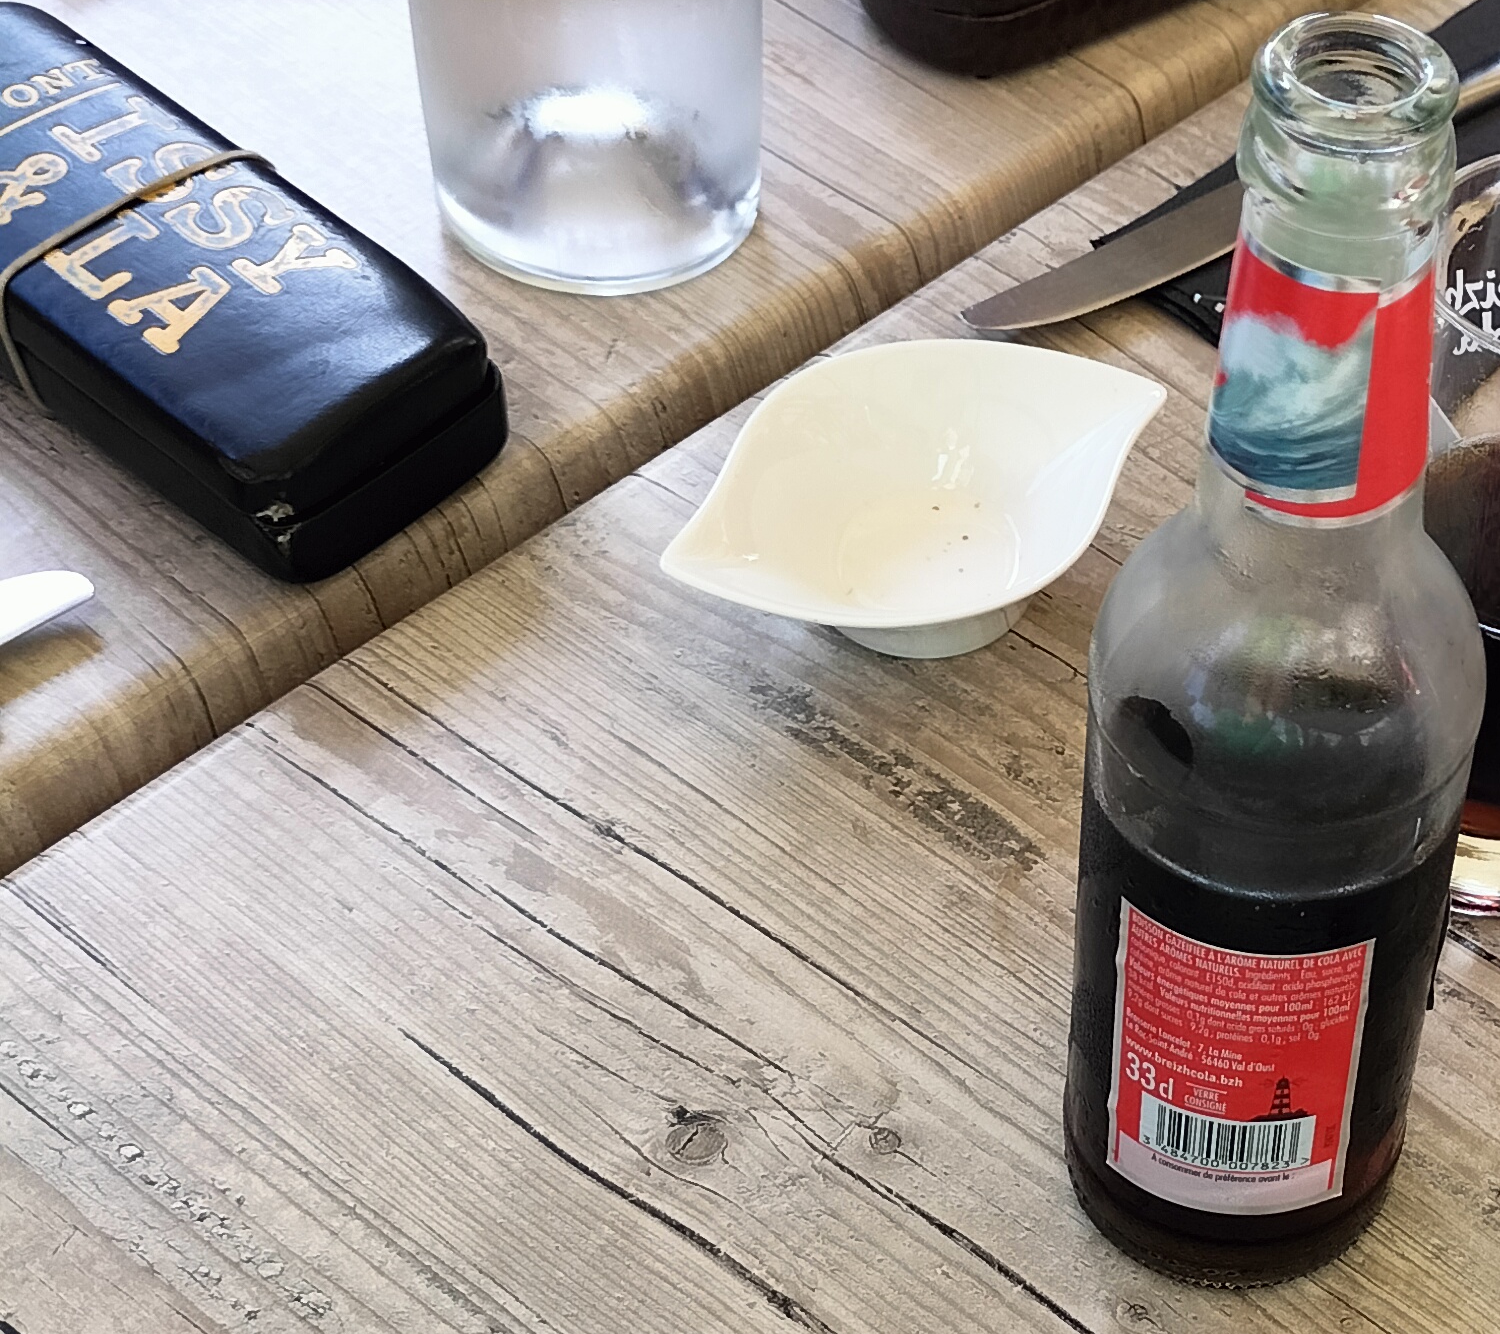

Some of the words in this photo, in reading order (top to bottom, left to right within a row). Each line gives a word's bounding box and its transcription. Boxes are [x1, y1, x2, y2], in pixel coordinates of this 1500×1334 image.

[1131, 923, 1158, 948] AUTRES
[1260, 959, 1300, 970] NATUREL
[1303, 958, 1315, 968] DE
[1317, 953, 1340, 966] COLA
[1342, 946, 1363, 962] AVEC
[1211, 997, 1256, 1013] moyennes
[1258, 1003, 1280, 1014] pour
[1252, 1014, 1298, 1025] moyennes
[1299, 1011, 1320, 1023] pour
[1158, 1027, 1190, 1049] Lancelot
[1208, 1046, 1219, 1057] La
[1125, 1035, 1243, 1088] www.breizhcola.bzh
[1231, 1060, 1246, 1072] Val
[1125, 1051, 1156, 1090] 33
[1159, 1077, 1174, 1101] cl
[1184, 1094, 1227, 1113] CONSIGNÉ
[1192, 1087, 1220, 1103] VERRE
[1158, 1157, 1202, 1178] consommer
[1202, 1170, 1214, 1180] de
[1214, 1171, 1257, 1184] préférence
[1257, 1175, 1281, 1183] avant
